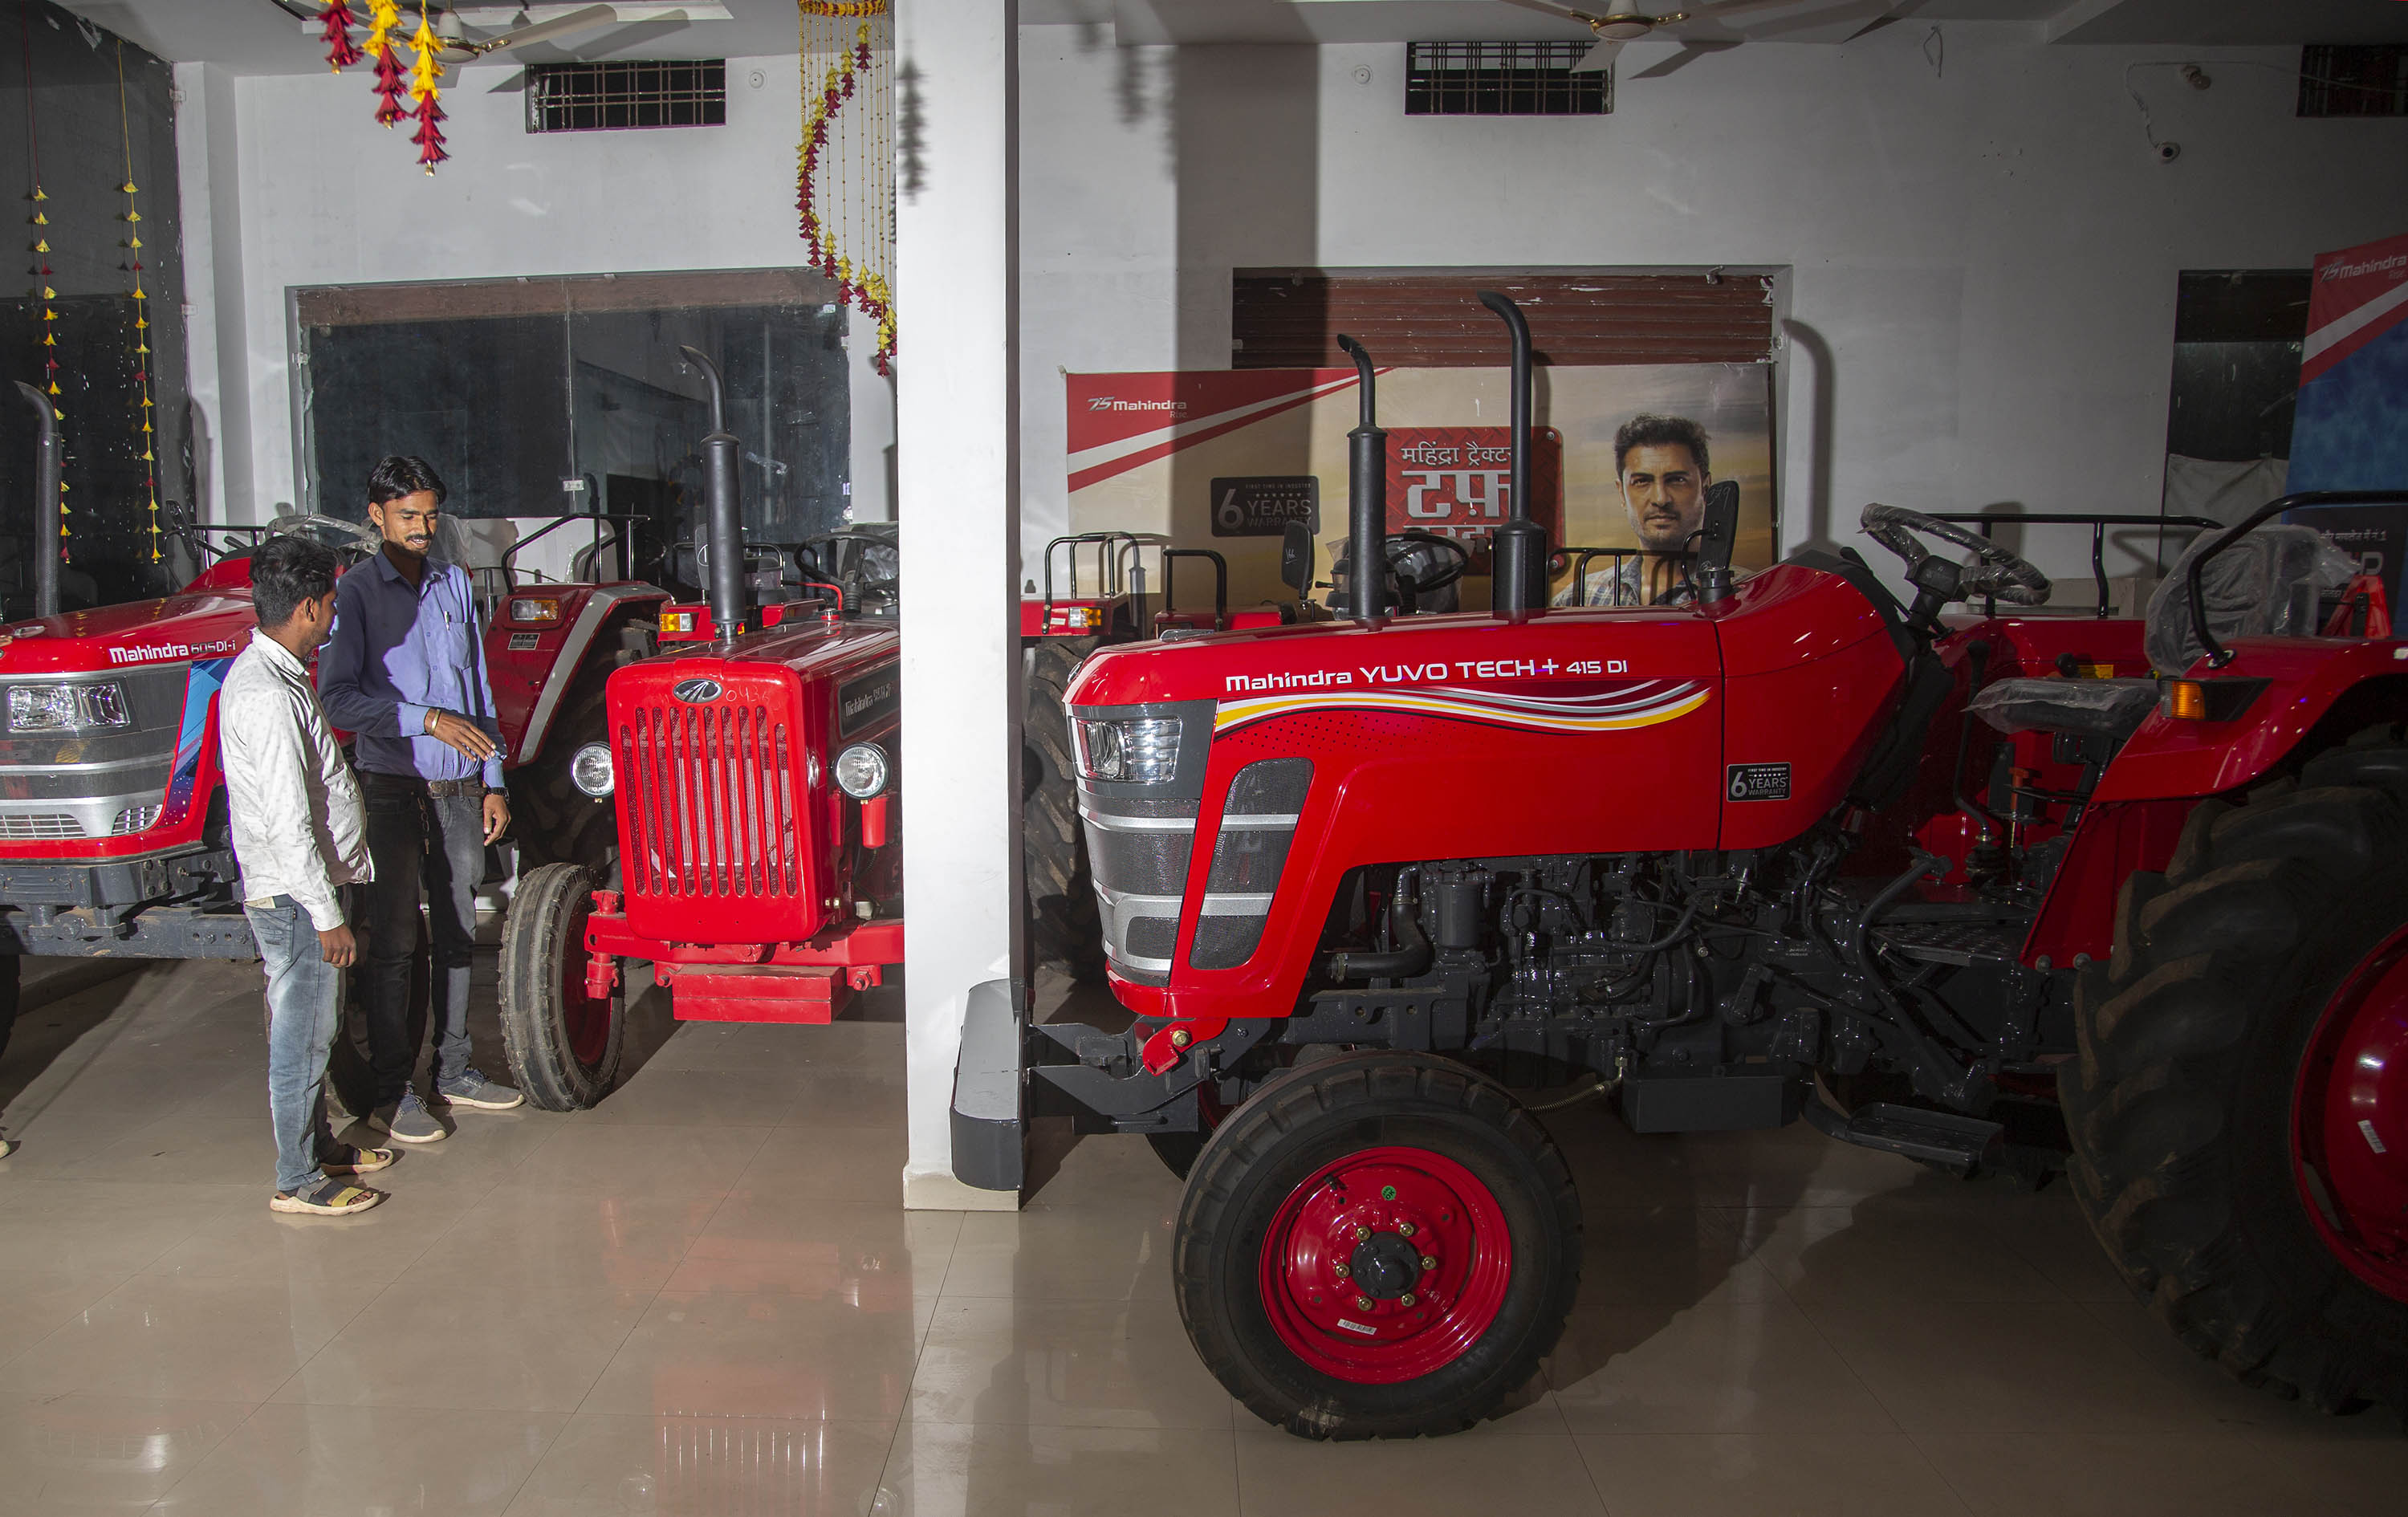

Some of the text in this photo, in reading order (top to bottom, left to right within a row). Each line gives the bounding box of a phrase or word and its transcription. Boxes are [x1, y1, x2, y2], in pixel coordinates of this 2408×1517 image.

[2339, 255, 2407, 279] Mahindra
[1113, 400, 1186, 411] Mahindra
[1401, 441, 1511, 466] महिंद्रा ट्रैक्ट
[1218, 488, 1244, 529] 6
[1247, 499, 1312, 515] YEARS
[109, 643, 189, 663] Mahindra
[1226, 670, 1352, 692] Mahindra
[1359, 660, 1448, 684] YUVO
[1565, 661, 1602, 675] 415
[1607, 659, 1628, 674] DI
[1731, 771, 1747, 798] 6
[1748, 778, 1787, 789] YEARS
[1748, 787, 1787, 796] WARRANTY
